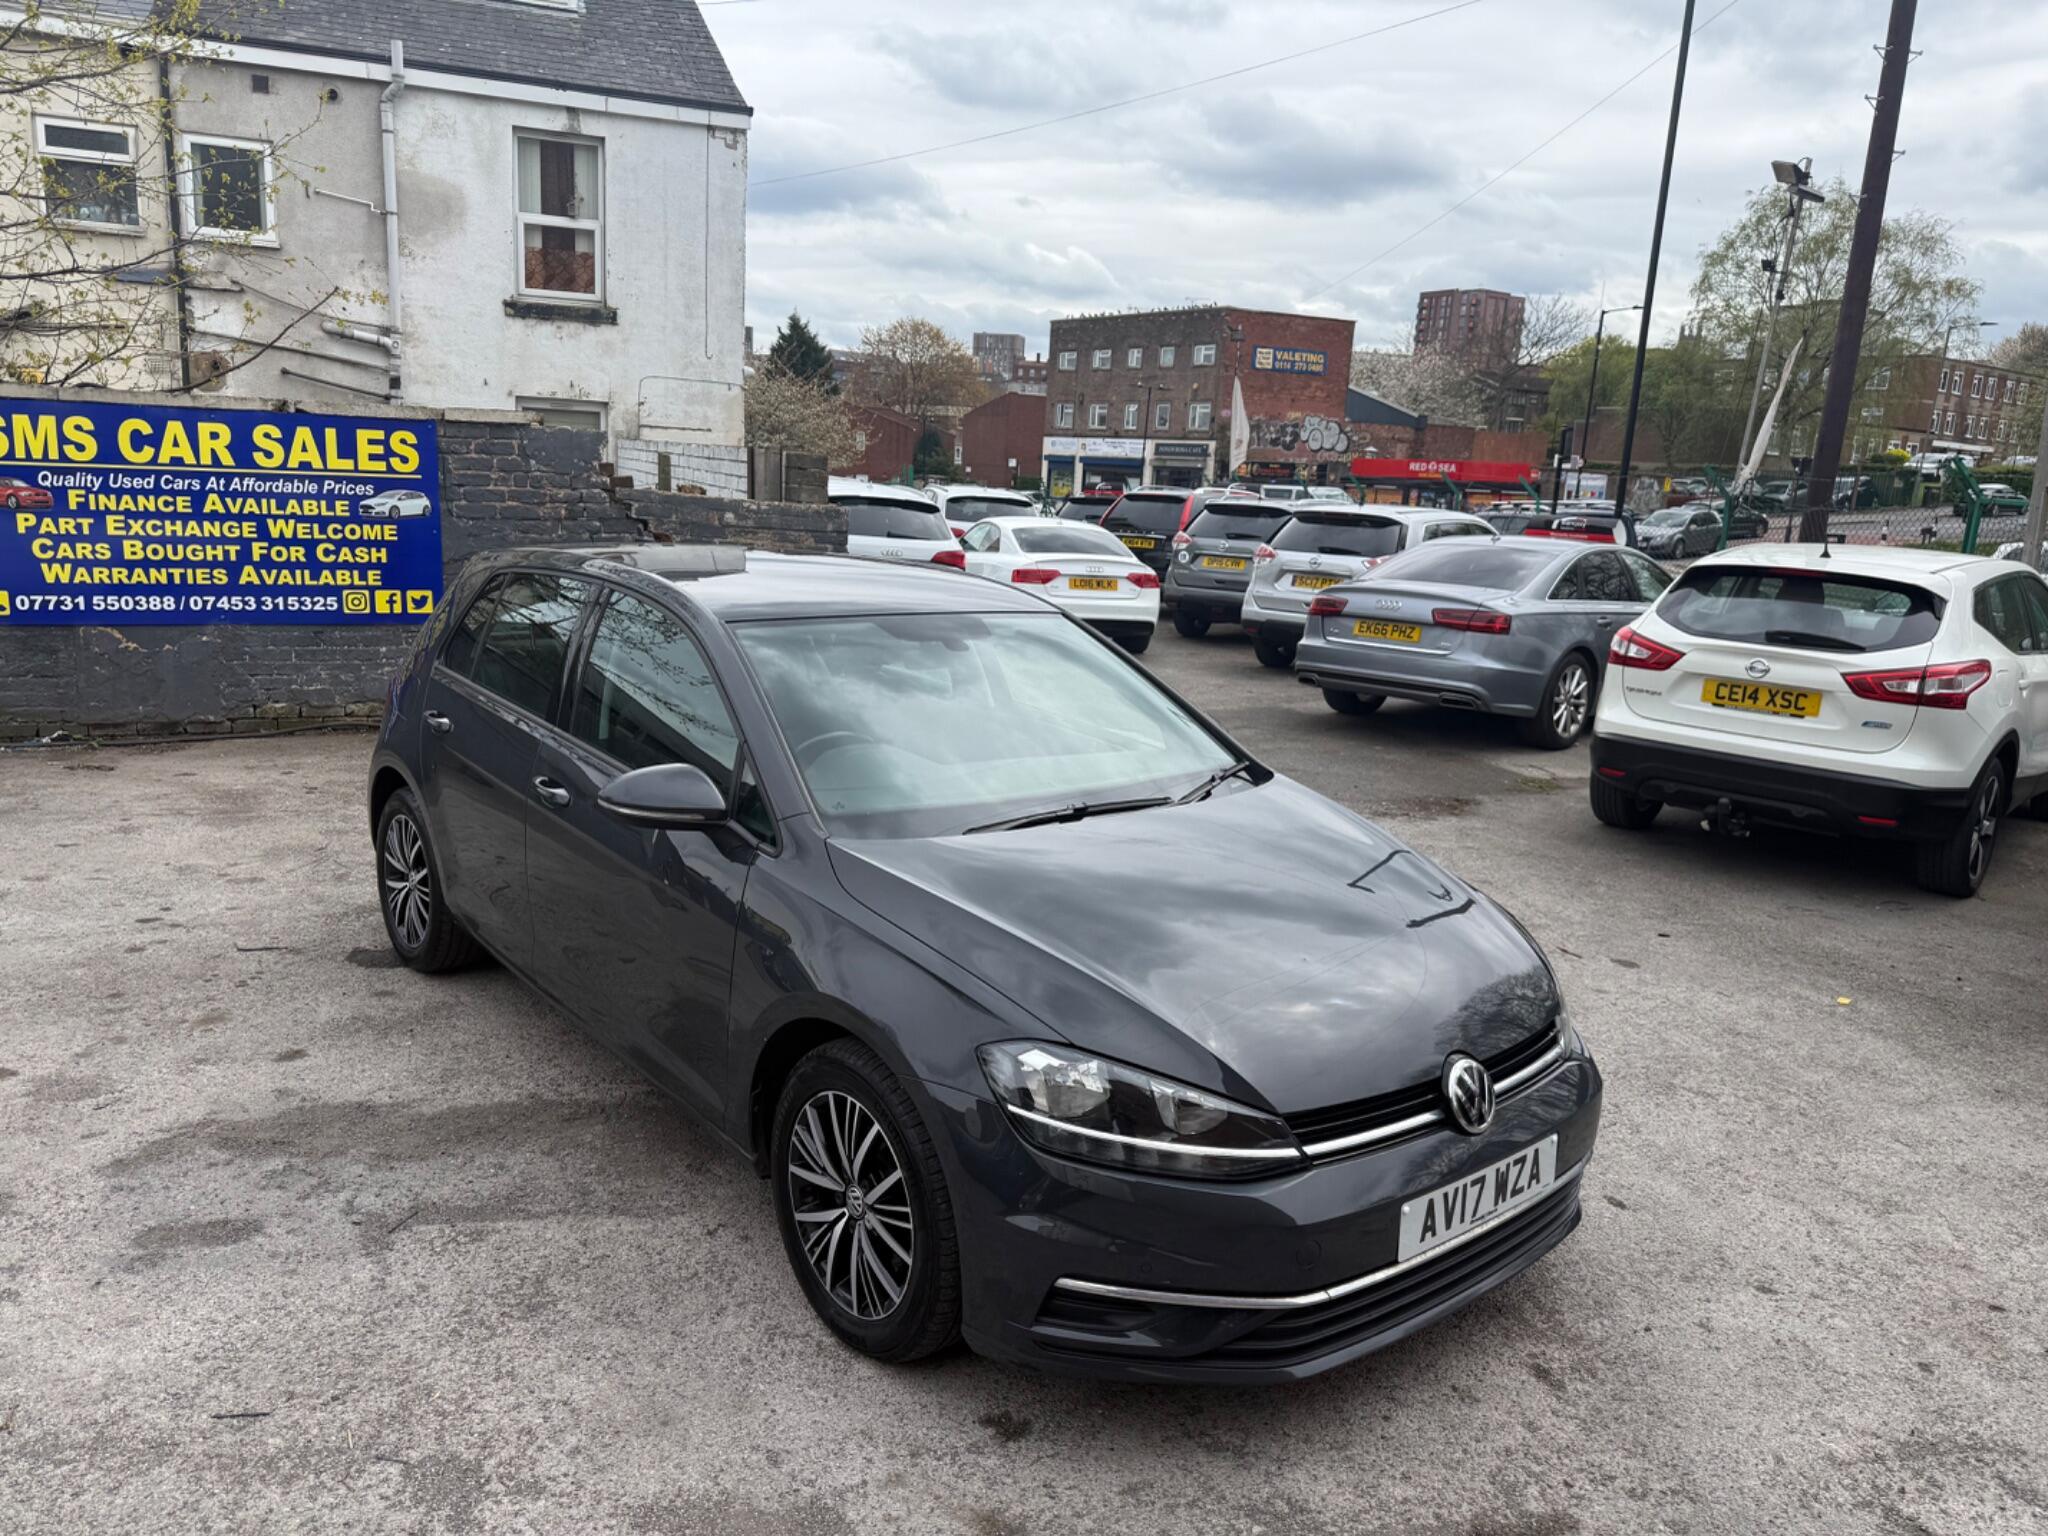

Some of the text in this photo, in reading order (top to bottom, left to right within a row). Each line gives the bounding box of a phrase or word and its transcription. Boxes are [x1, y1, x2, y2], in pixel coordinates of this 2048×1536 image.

[1275, 350, 1324, 363] VALETING
[0, 413, 420, 473] MS CAR SALES
[1409, 461, 1457, 473] RED SEA
[37, 470, 375, 495] Quality Used Cars At Affordable Prices
[67, 489, 350, 517] FINANCE AVAILABLE
[16, 512, 399, 541] PART EXCHANGE WELCOME
[31, 537, 388, 563] CARS BOUGHT FOR CASH
[40, 563, 383, 586] WARRANTIES AVAILABLE
[15, 595, 85, 611] 07731
[92, 596, 177, 611] 550388
[189, 596, 257, 611] 07453
[260, 596, 338, 611] 315325
[1357, 621, 1416, 639] EK66 PHZ
[1714, 682, 1760, 704] CE14
[1765, 688, 1808, 711] XSC
[1419, 1148, 1540, 1243] AV17 WZA
